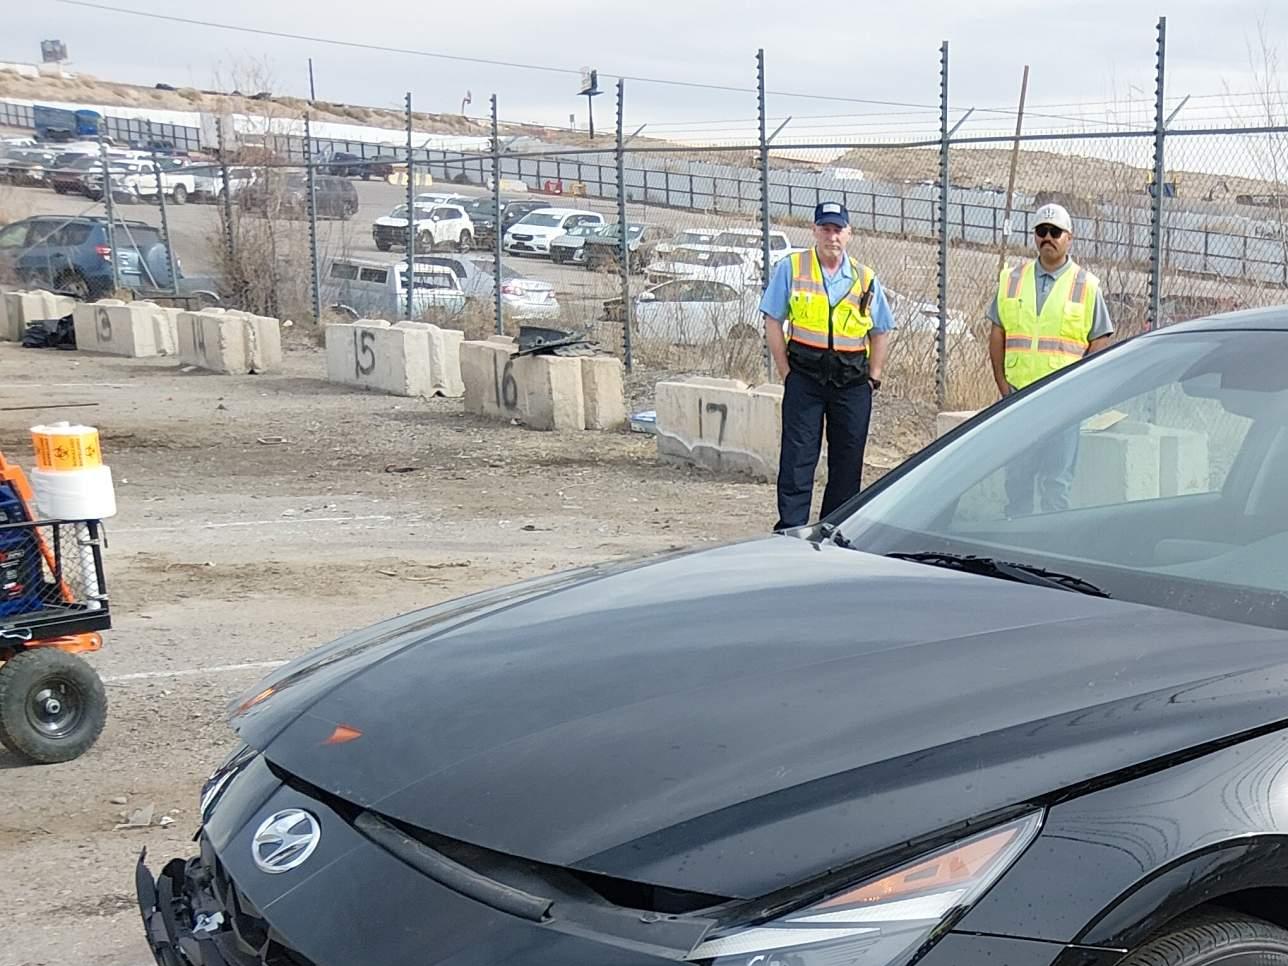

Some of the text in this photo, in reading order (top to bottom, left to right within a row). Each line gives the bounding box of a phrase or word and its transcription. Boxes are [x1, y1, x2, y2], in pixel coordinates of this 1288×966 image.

[353, 326, 376, 379] 15
[492, 350, 519, 411] 16
[698, 397, 728, 448] 17
